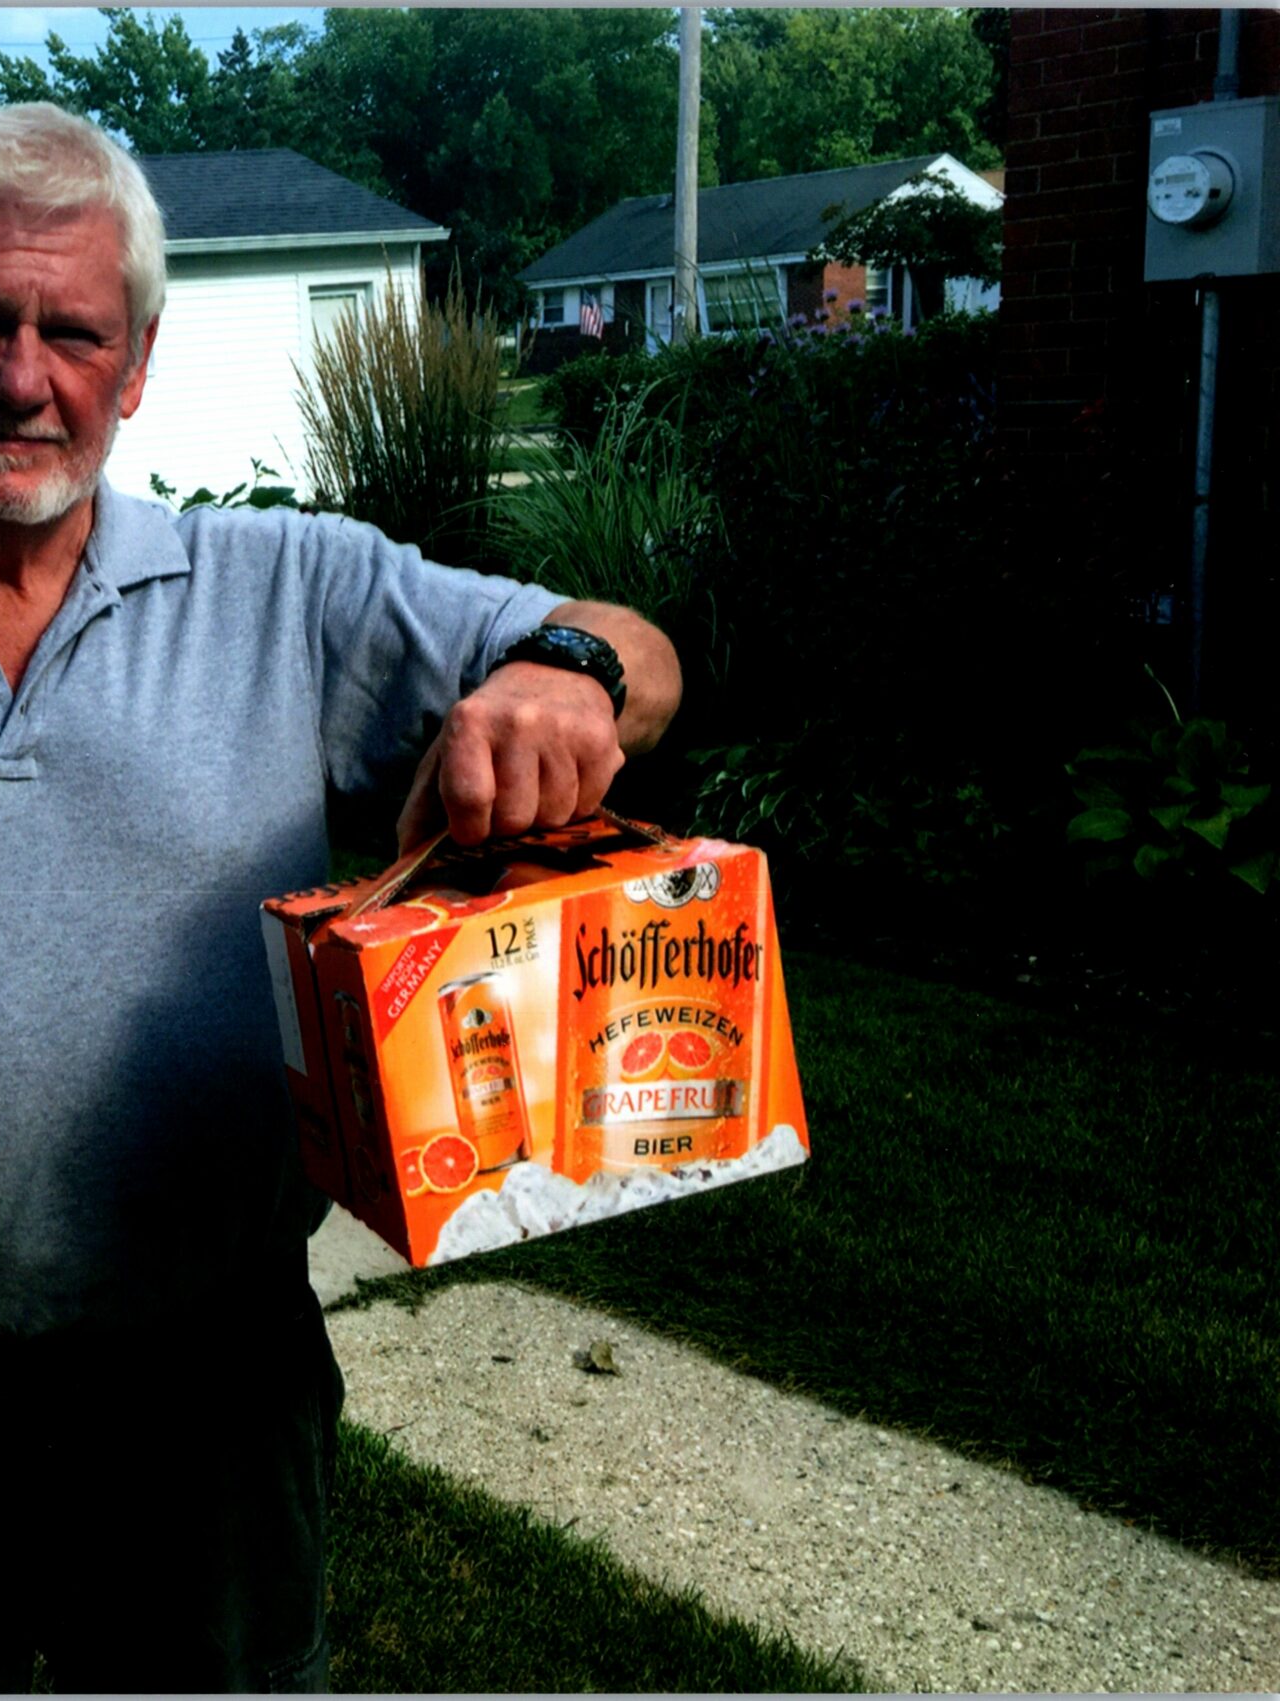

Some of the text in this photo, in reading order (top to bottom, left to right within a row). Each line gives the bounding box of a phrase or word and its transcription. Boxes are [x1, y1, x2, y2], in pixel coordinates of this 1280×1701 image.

[486, 922, 521, 959] 12
[523, 916, 538, 950] PACK
[381, 944, 417, 993] IMPORTED
[395, 959, 417, 989] FROM
[573, 918, 763, 1001] Schöfferhofer
[387, 940, 443, 1019] GERMANY
[589, 1006, 744, 1053] HEFEWEIZEN
[584, 1086, 738, 1119] GRAPEFRUIT
[634, 1136, 693, 1155] BIER
